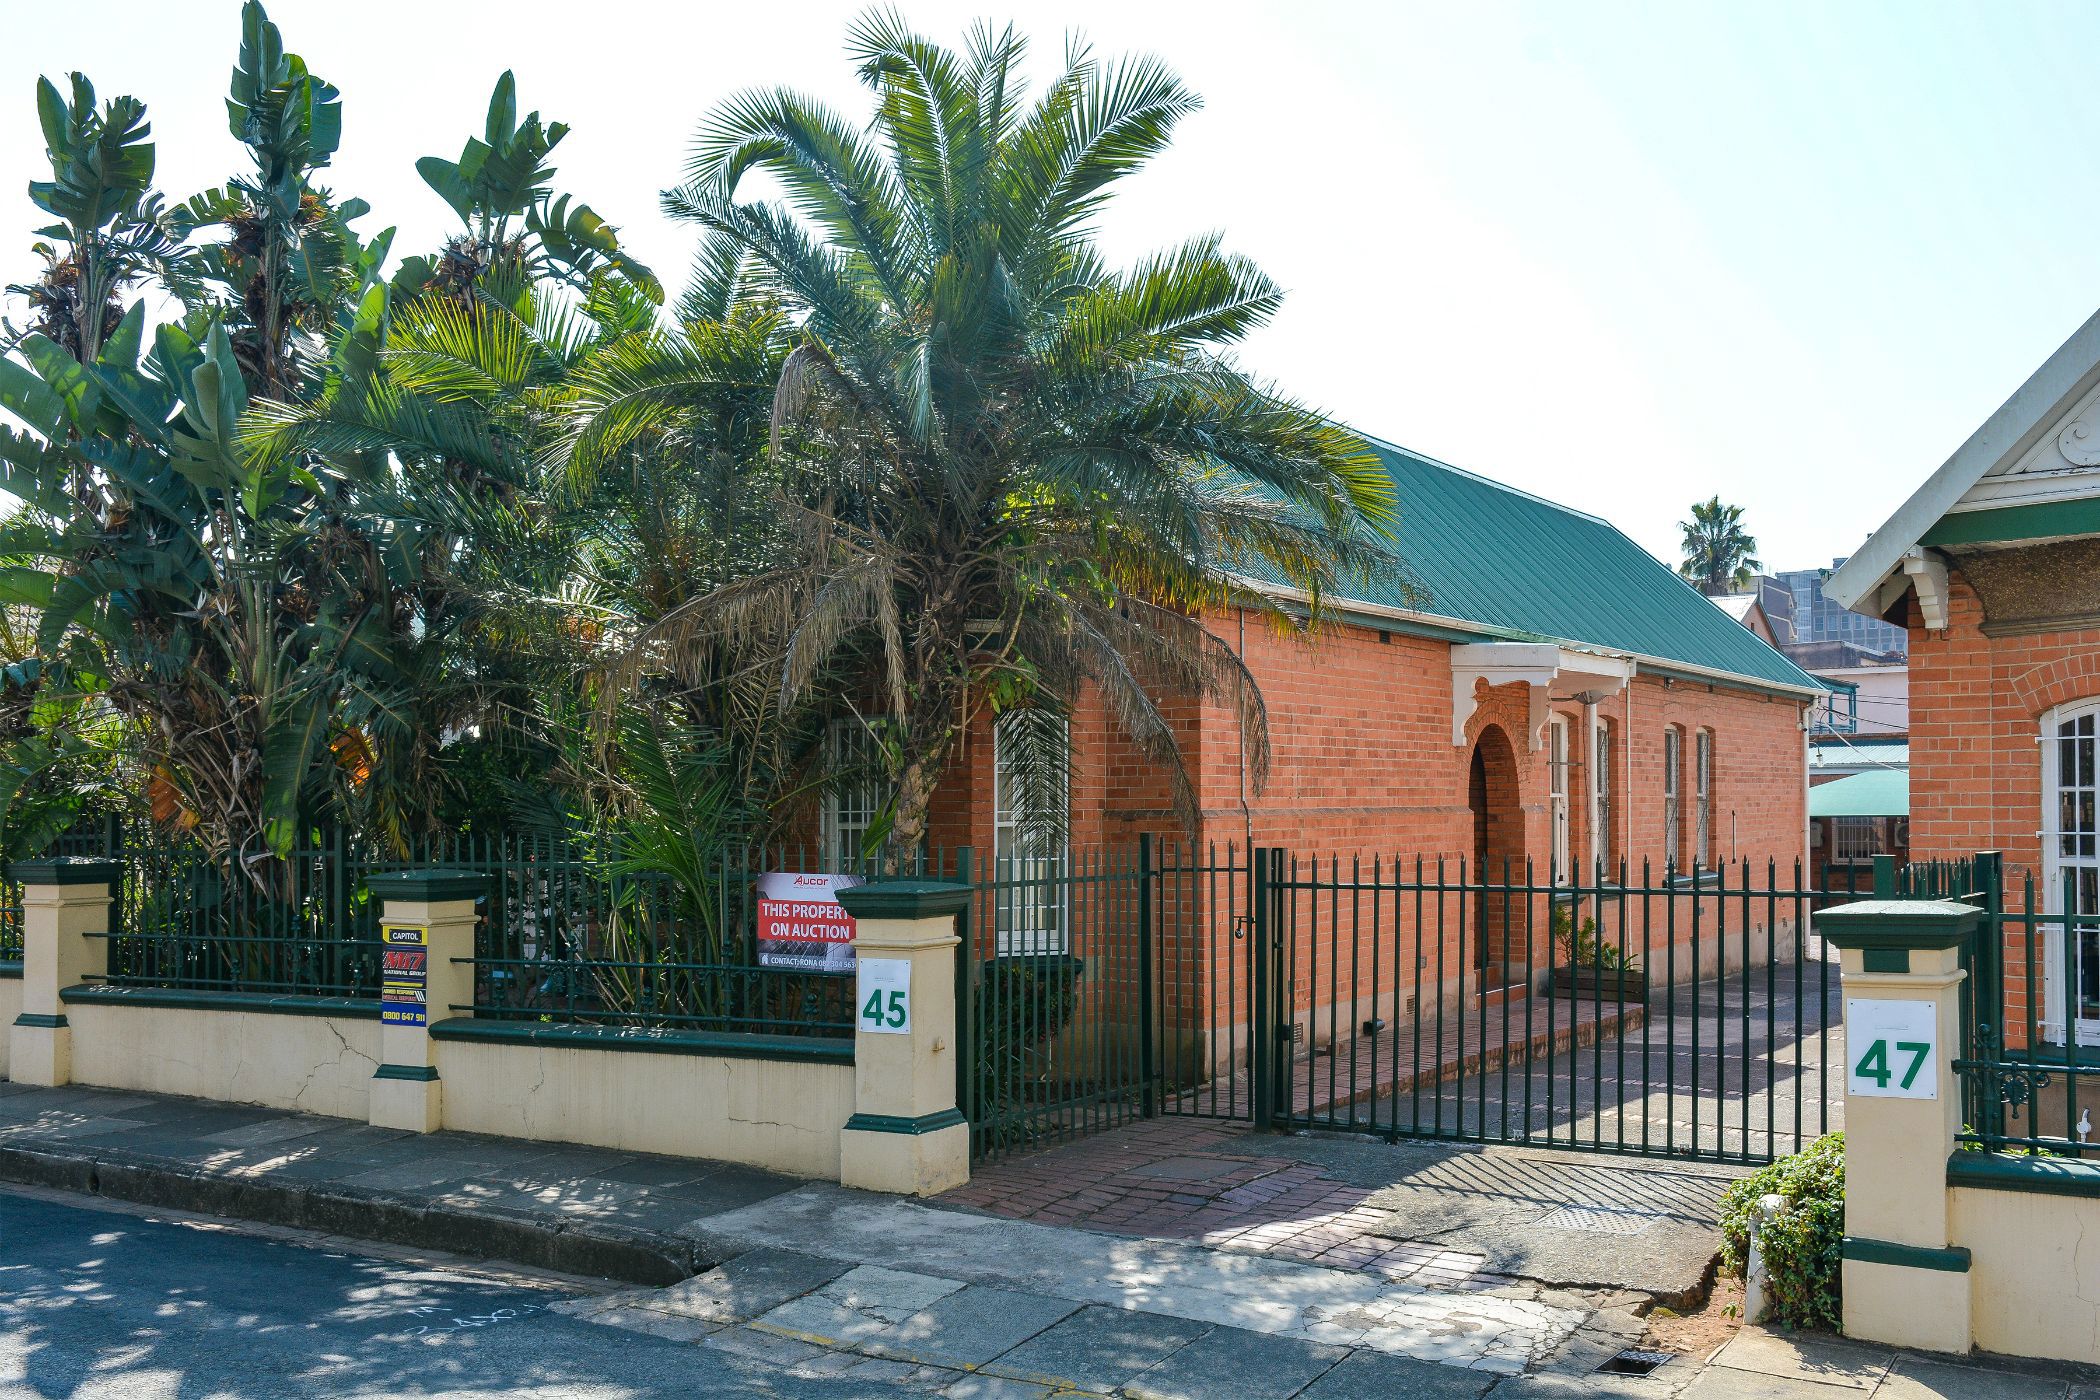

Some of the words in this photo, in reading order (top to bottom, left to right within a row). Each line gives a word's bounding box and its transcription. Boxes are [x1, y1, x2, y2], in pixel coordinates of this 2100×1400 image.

[793, 875, 829, 886] Aucor
[762, 902, 790, 918] THIS
[792, 904, 855, 920] PROPERT
[392, 932, 419, 941] CAPITOL
[770, 922, 789, 937] ON
[791, 923, 850, 939] AUCTION
[843, 961, 856, 969] 563
[862, 988, 906, 1028] 45
[383, 1011, 401, 1020] 0800
[402, 1012, 415, 1021] 647
[416, 1013, 425, 1022] 911
[1855, 1039, 1931, 1090] 47
